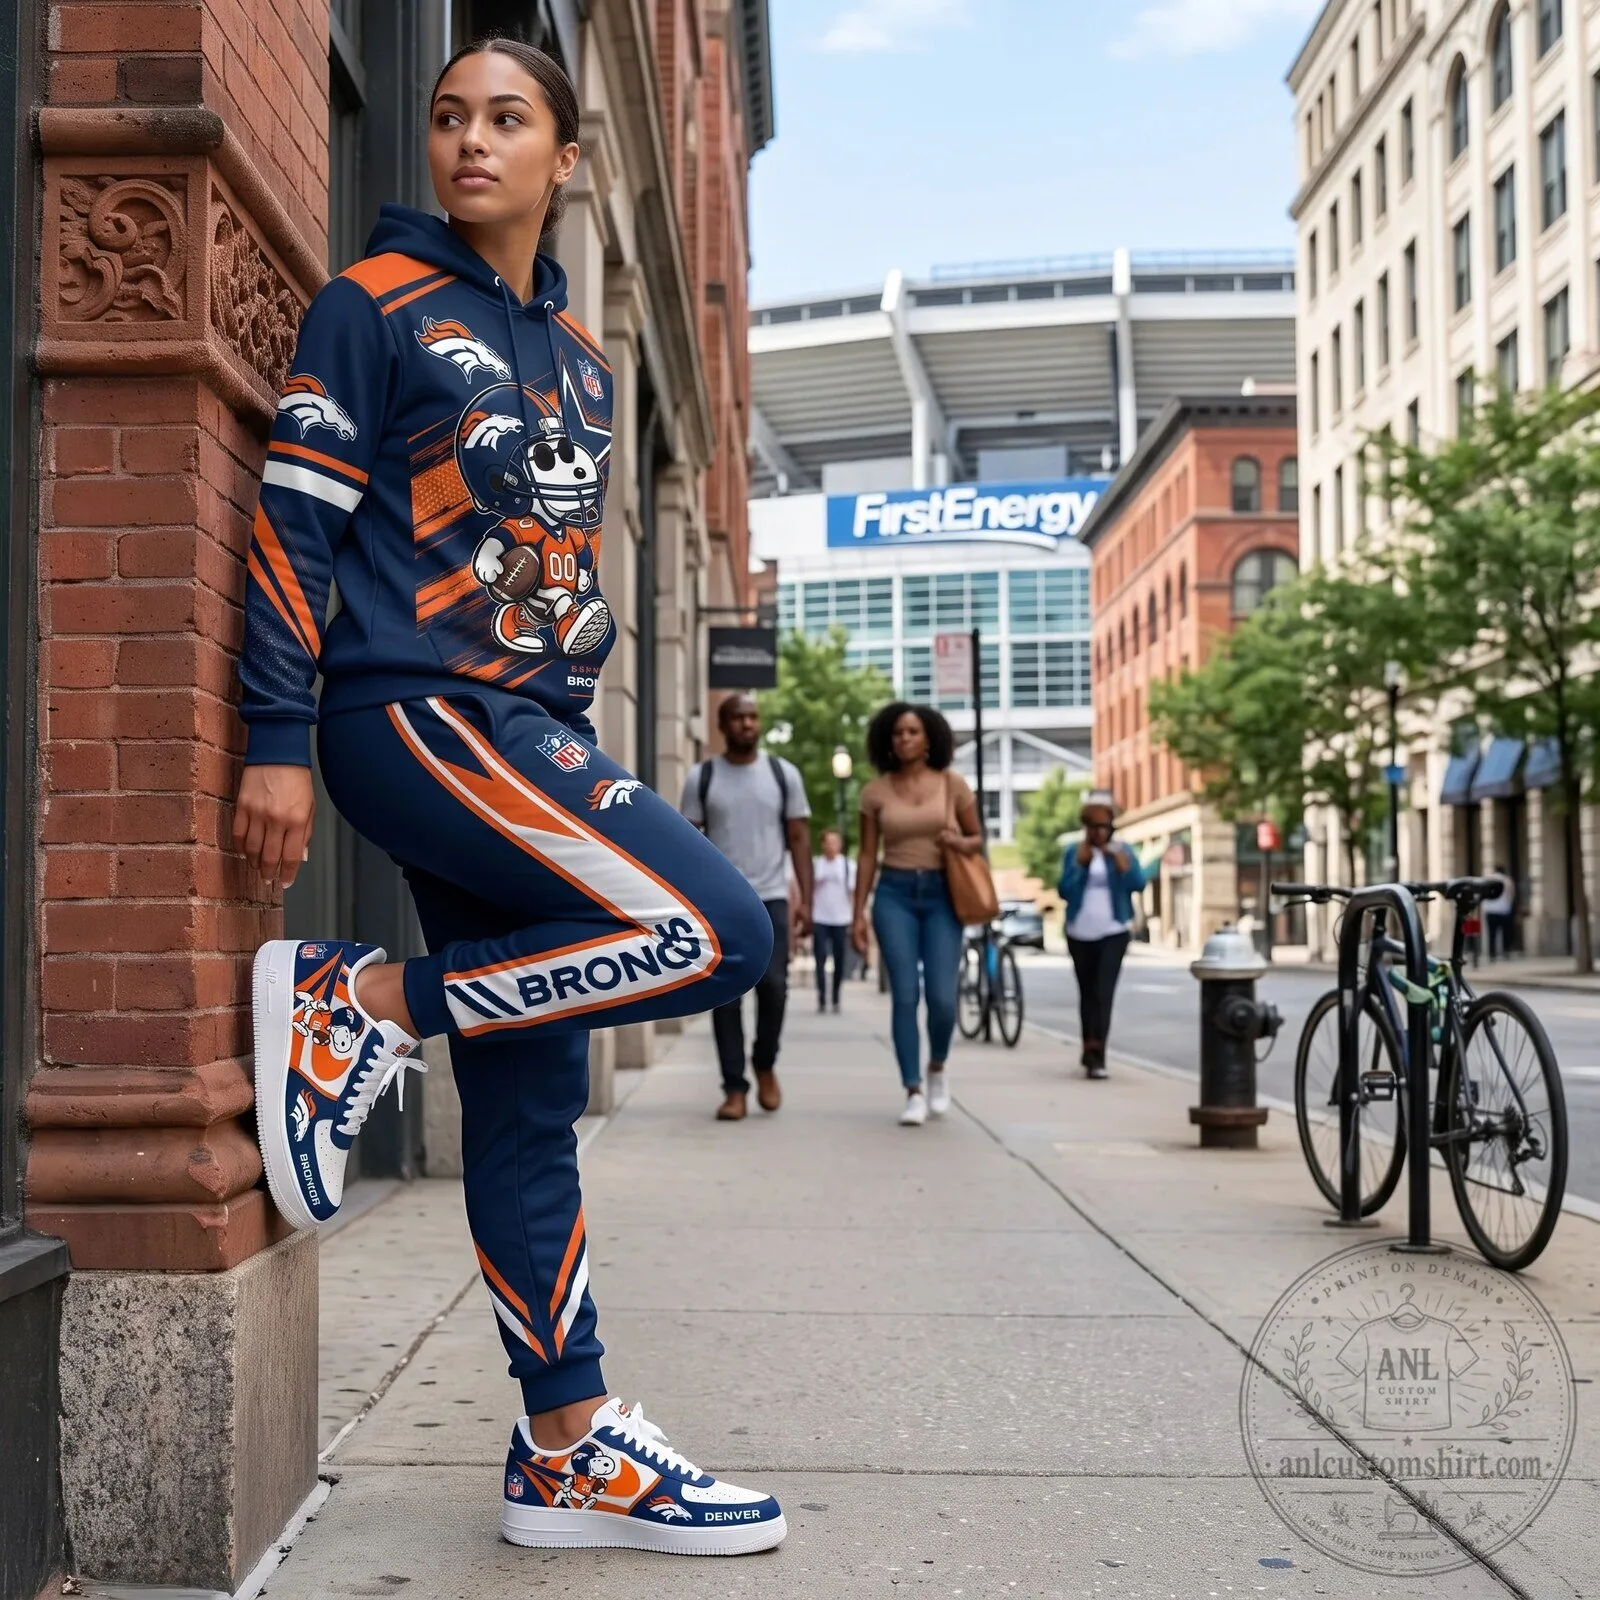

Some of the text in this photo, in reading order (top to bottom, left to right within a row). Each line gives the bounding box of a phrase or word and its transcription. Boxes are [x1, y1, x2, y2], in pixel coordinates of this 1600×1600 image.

[853, 487, 1099, 537] FirstEnergy
[549, 552, 576, 581] 00
[704, 1509, 761, 1522] DENVER
